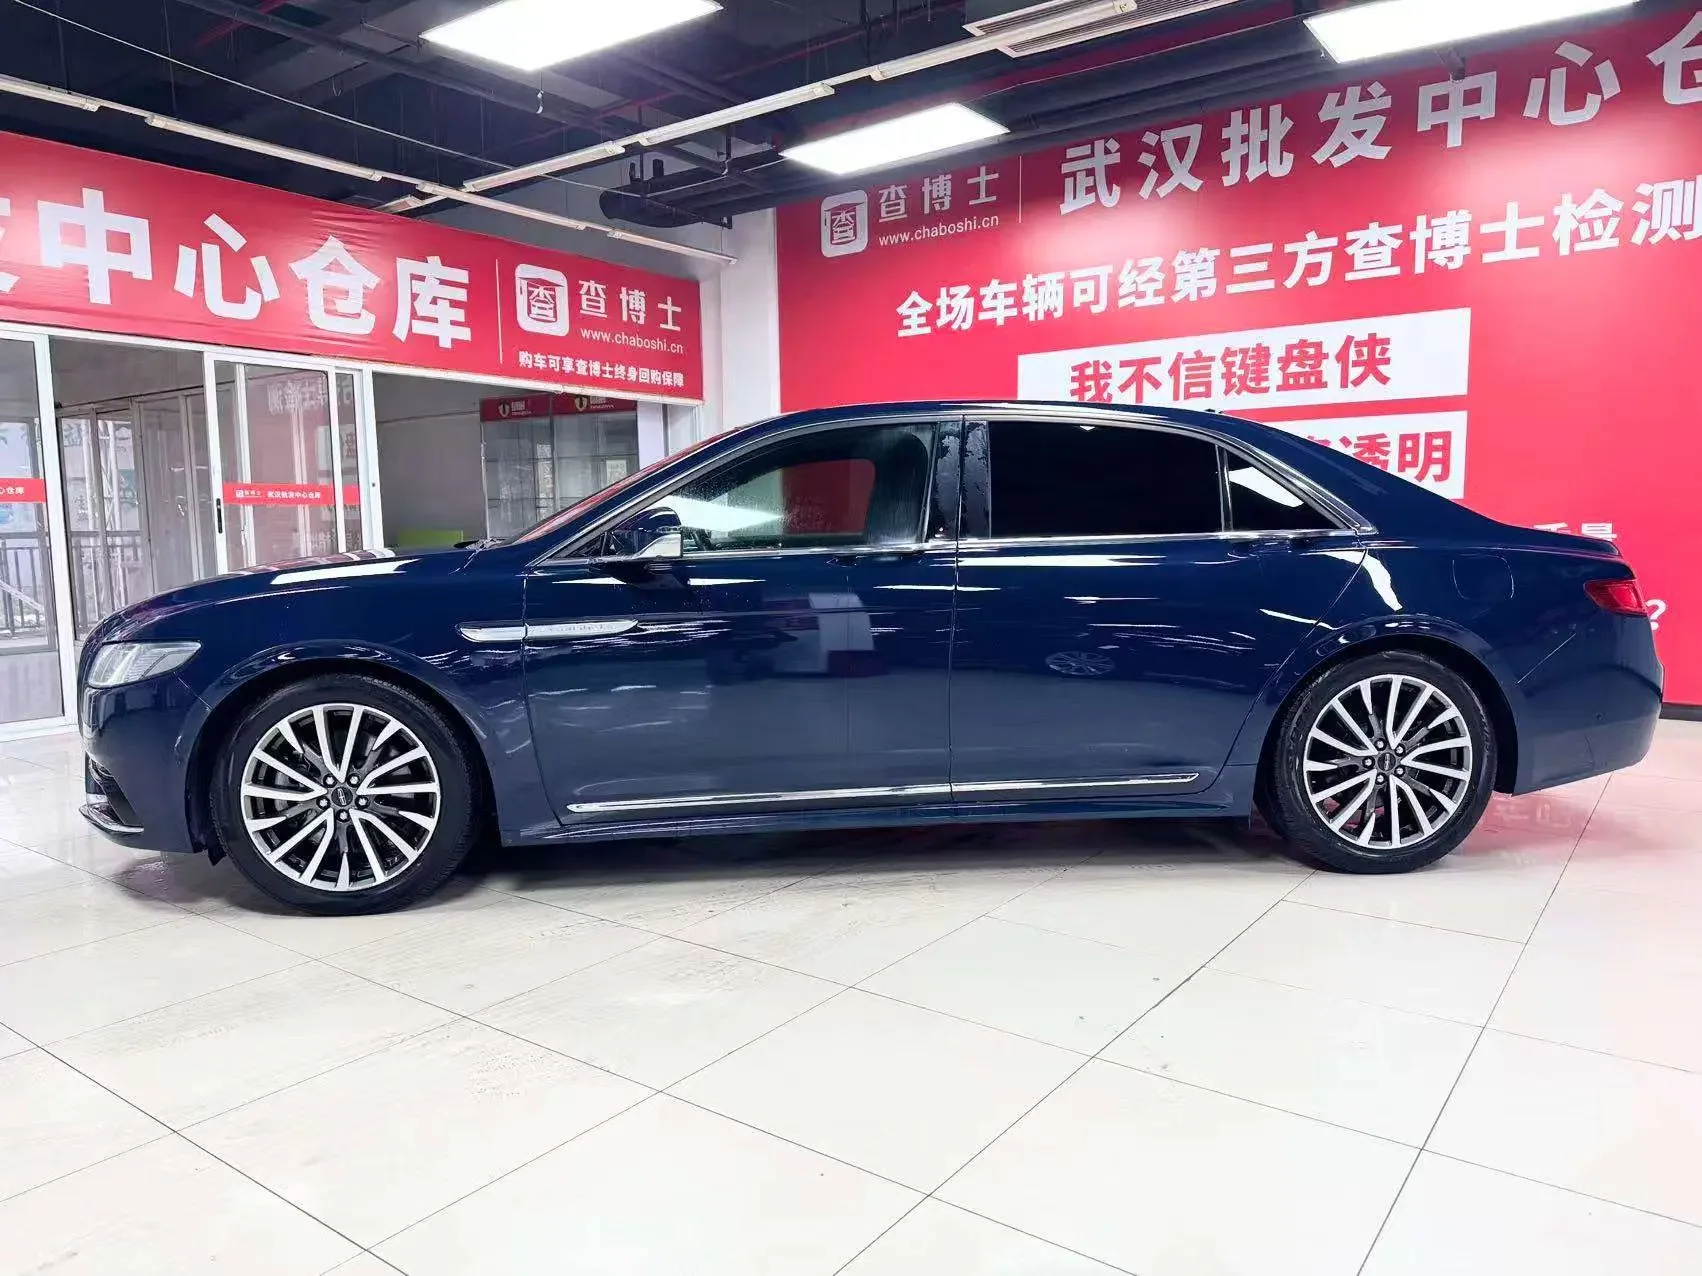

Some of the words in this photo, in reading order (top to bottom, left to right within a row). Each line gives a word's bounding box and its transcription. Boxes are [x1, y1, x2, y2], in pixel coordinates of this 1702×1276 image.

[878, 215, 1000, 247] www.chaboshi.cn
[895, 174, 1702, 338] 全场车辆可经第三方查博士检测
[0, 187, 472, 349] 中心仓库
[580, 327, 683, 354] www.chaboshi.cn
[1070, 332, 1392, 402] 我不信键盘侠
[518, 350, 685, 388] 购车可享查博士终身回购保障
[1307, 430, 1452, 483] 透明
